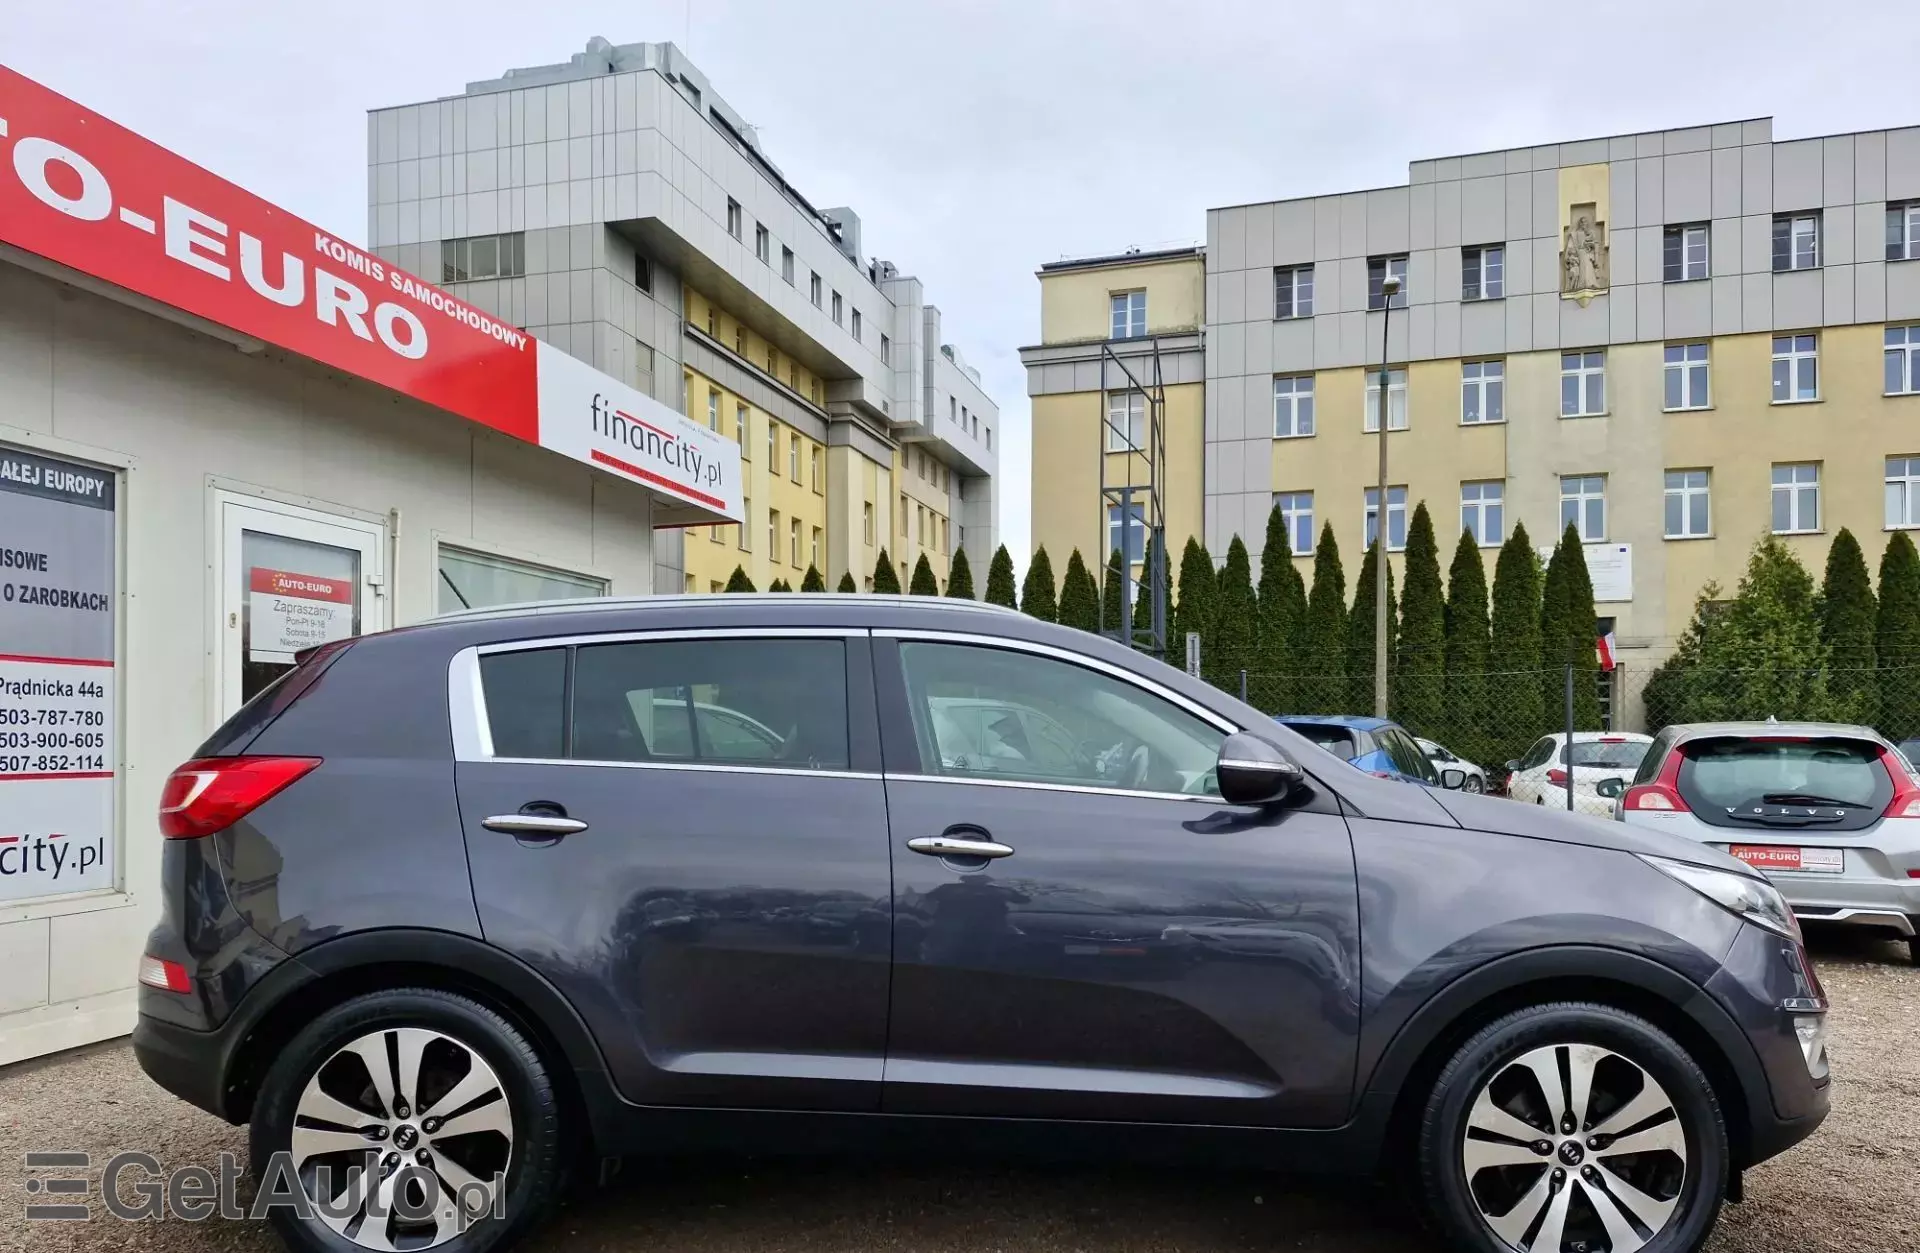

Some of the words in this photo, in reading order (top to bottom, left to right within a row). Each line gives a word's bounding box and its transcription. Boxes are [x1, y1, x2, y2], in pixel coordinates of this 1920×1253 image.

[0, 117, 428, 360] O-EURO
[315, 232, 384, 282] KOMIS
[390, 271, 527, 352] SAMOCHODOWY
[591, 393, 722, 487] financity.pl
[0, 460, 40, 485] AŁEJ
[45, 469, 104, 497] EUROPY
[279, 579, 332, 594] AUTO-EURO
[4, 583, 14, 602] O
[19, 585, 108, 612] ZAROBKACH
[273, 600, 336, 620] Zapraszamy:
[78, 681, 103, 698] 44a
[0, 709, 104, 726] 503-787-780
[0, 732, 104, 748] 503-900-605
[0, 755, 104, 771] 507-852-114
[1726, 807, 1845, 817] VOLVO
[1738, 851, 1799, 862] AUTO-EURO
[1562, 1143, 1581, 1163] KIA
